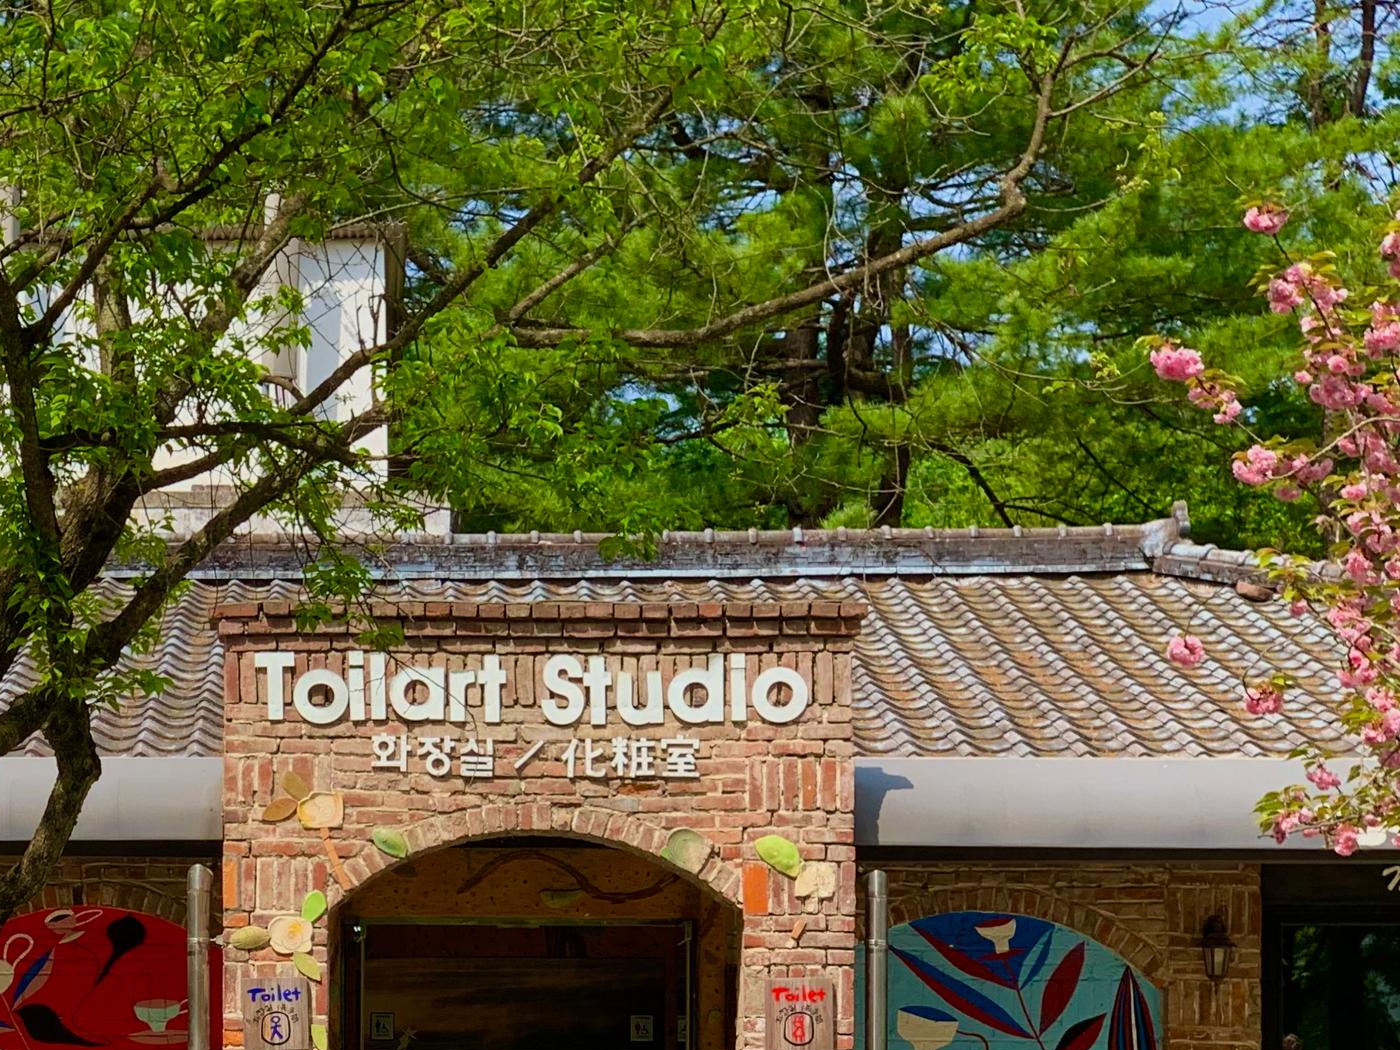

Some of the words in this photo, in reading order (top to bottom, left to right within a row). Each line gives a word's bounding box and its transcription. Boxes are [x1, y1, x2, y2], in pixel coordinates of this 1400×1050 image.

[253, 650, 506, 725] Toilart
[541, 653, 809, 727] Studio
[371, 733, 496, 779] 화장실
[561, 734, 701, 779] 化粧室
[247, 984, 302, 1002] Toilet
[771, 984, 827, 1004] Toilet
